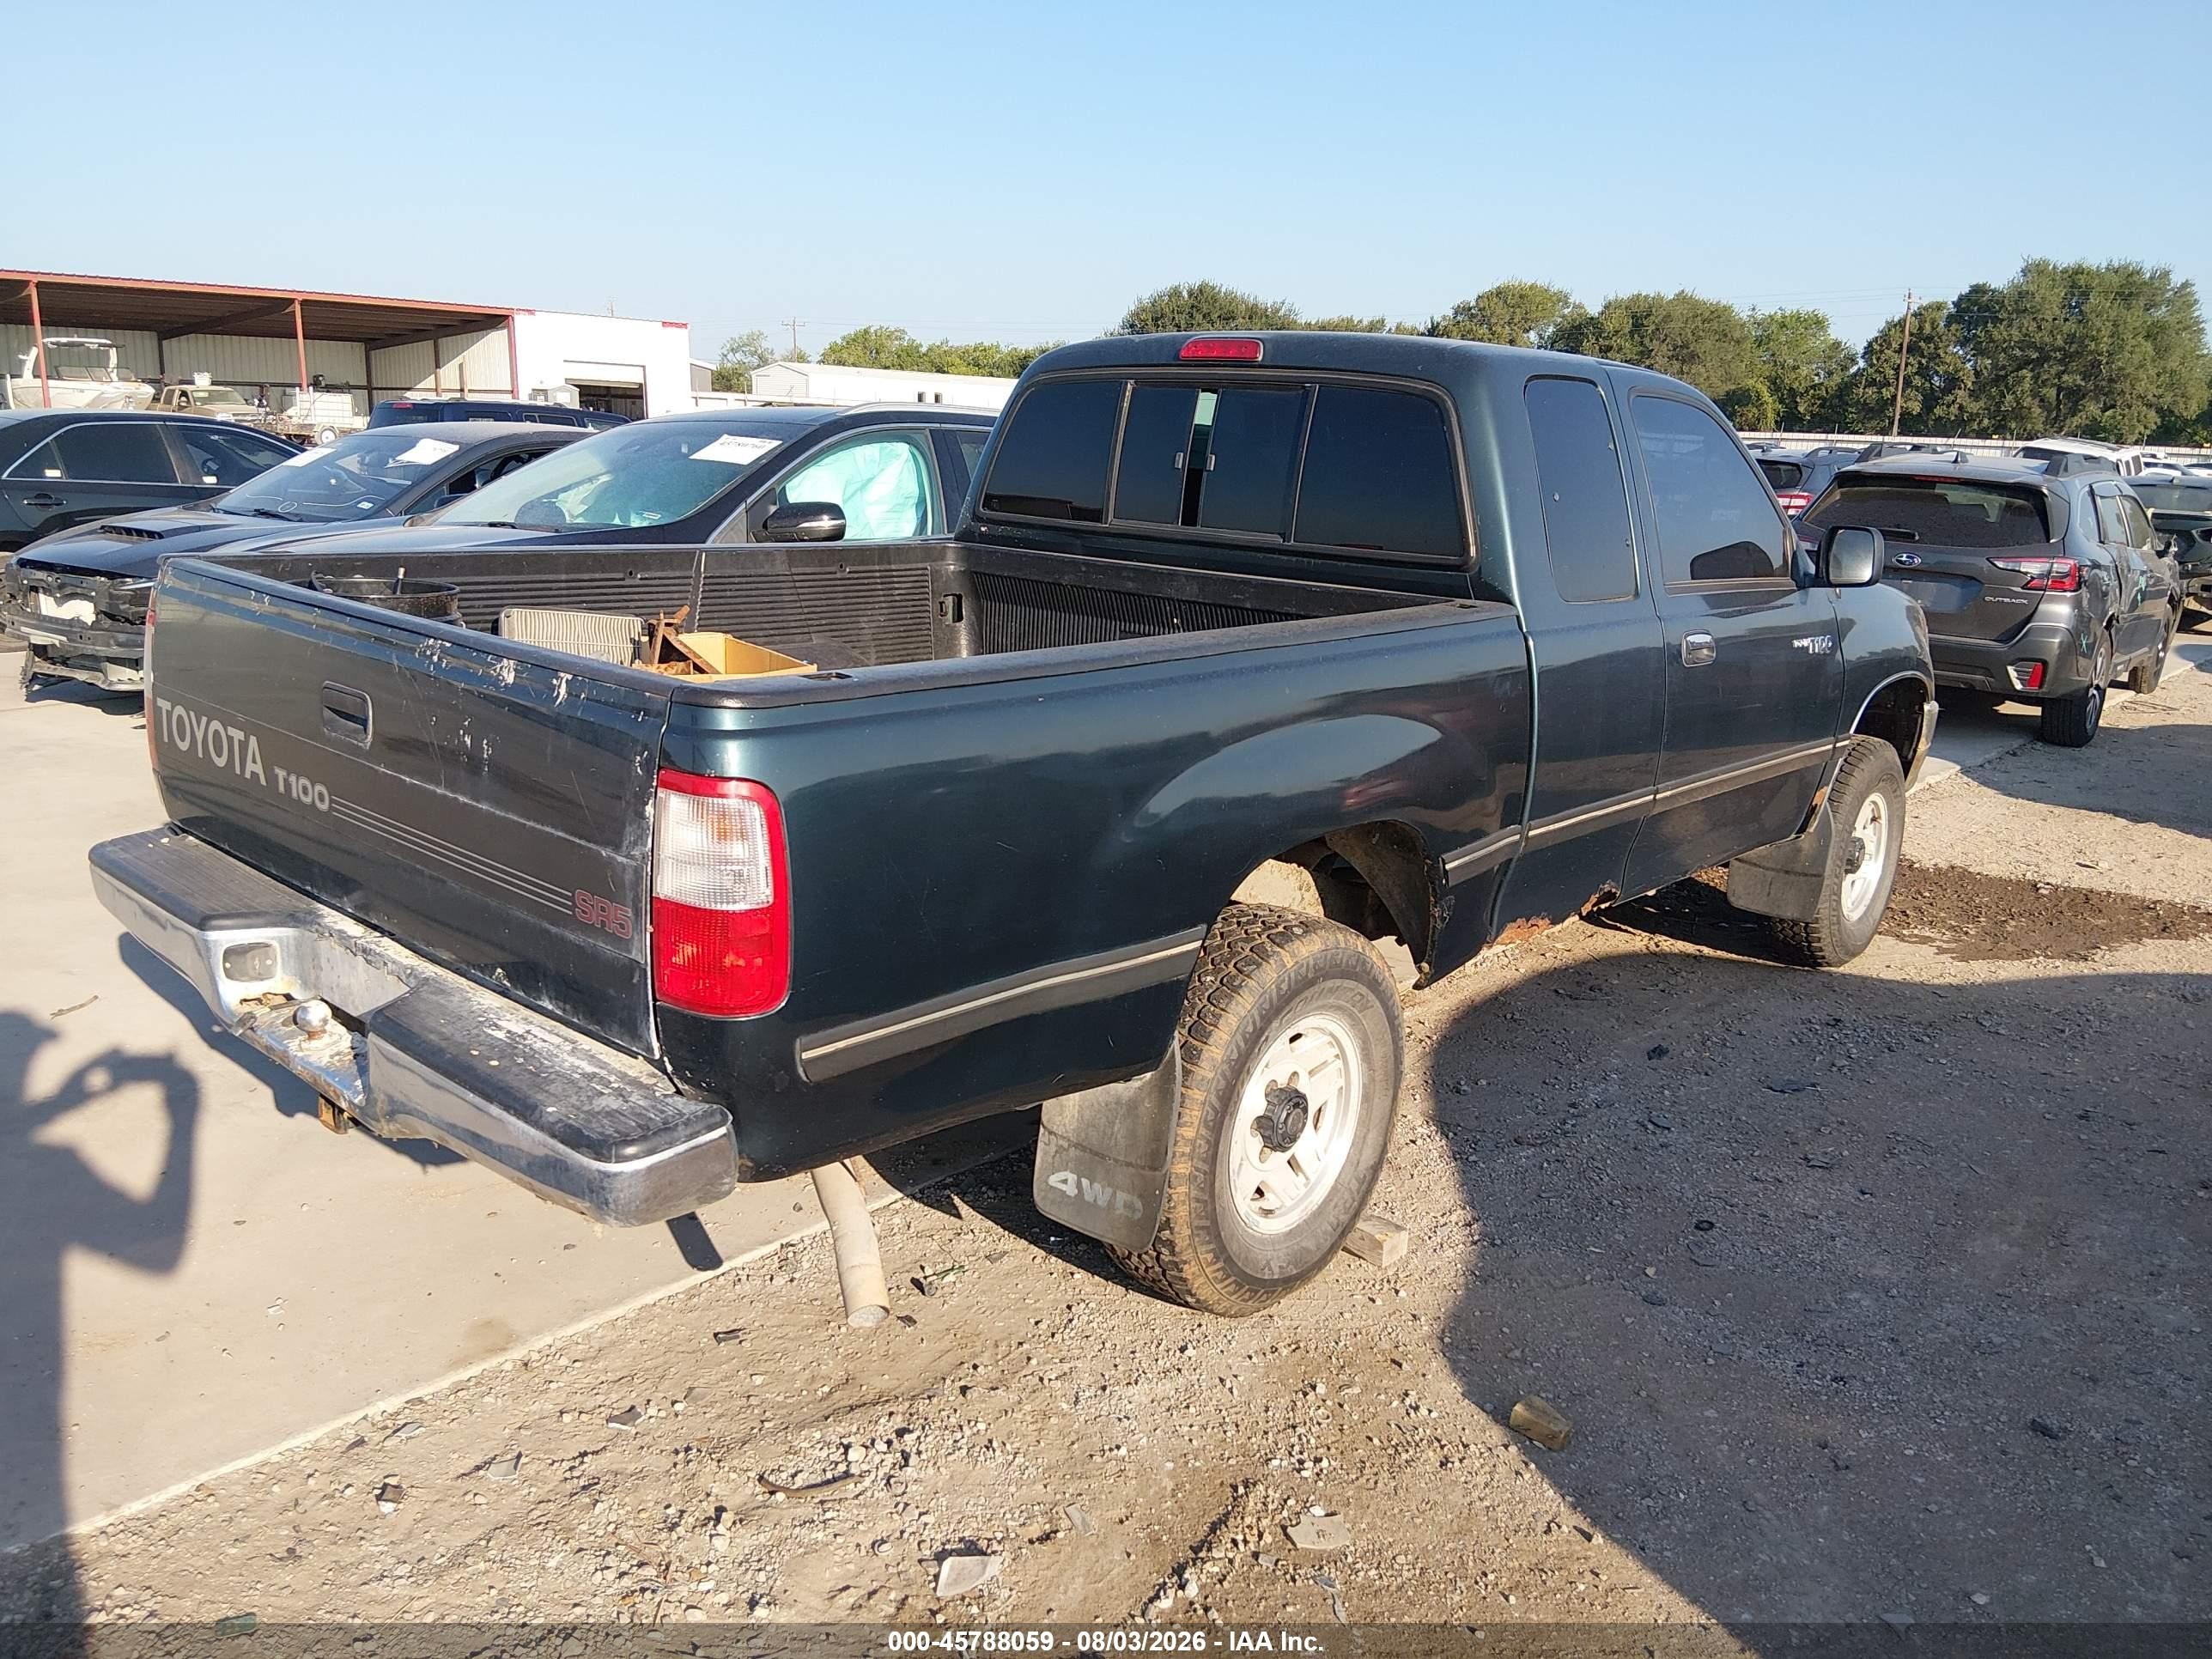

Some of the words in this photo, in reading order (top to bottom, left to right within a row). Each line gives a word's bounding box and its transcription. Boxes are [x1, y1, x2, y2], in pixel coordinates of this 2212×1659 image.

[1984, 596, 2028, 605] OUTBACK
[156, 697, 267, 786] TOYOTA
[273, 765, 330, 812] T100
[574, 889, 632, 939] SR5
[1048, 1170, 1143, 1219] 4WD
